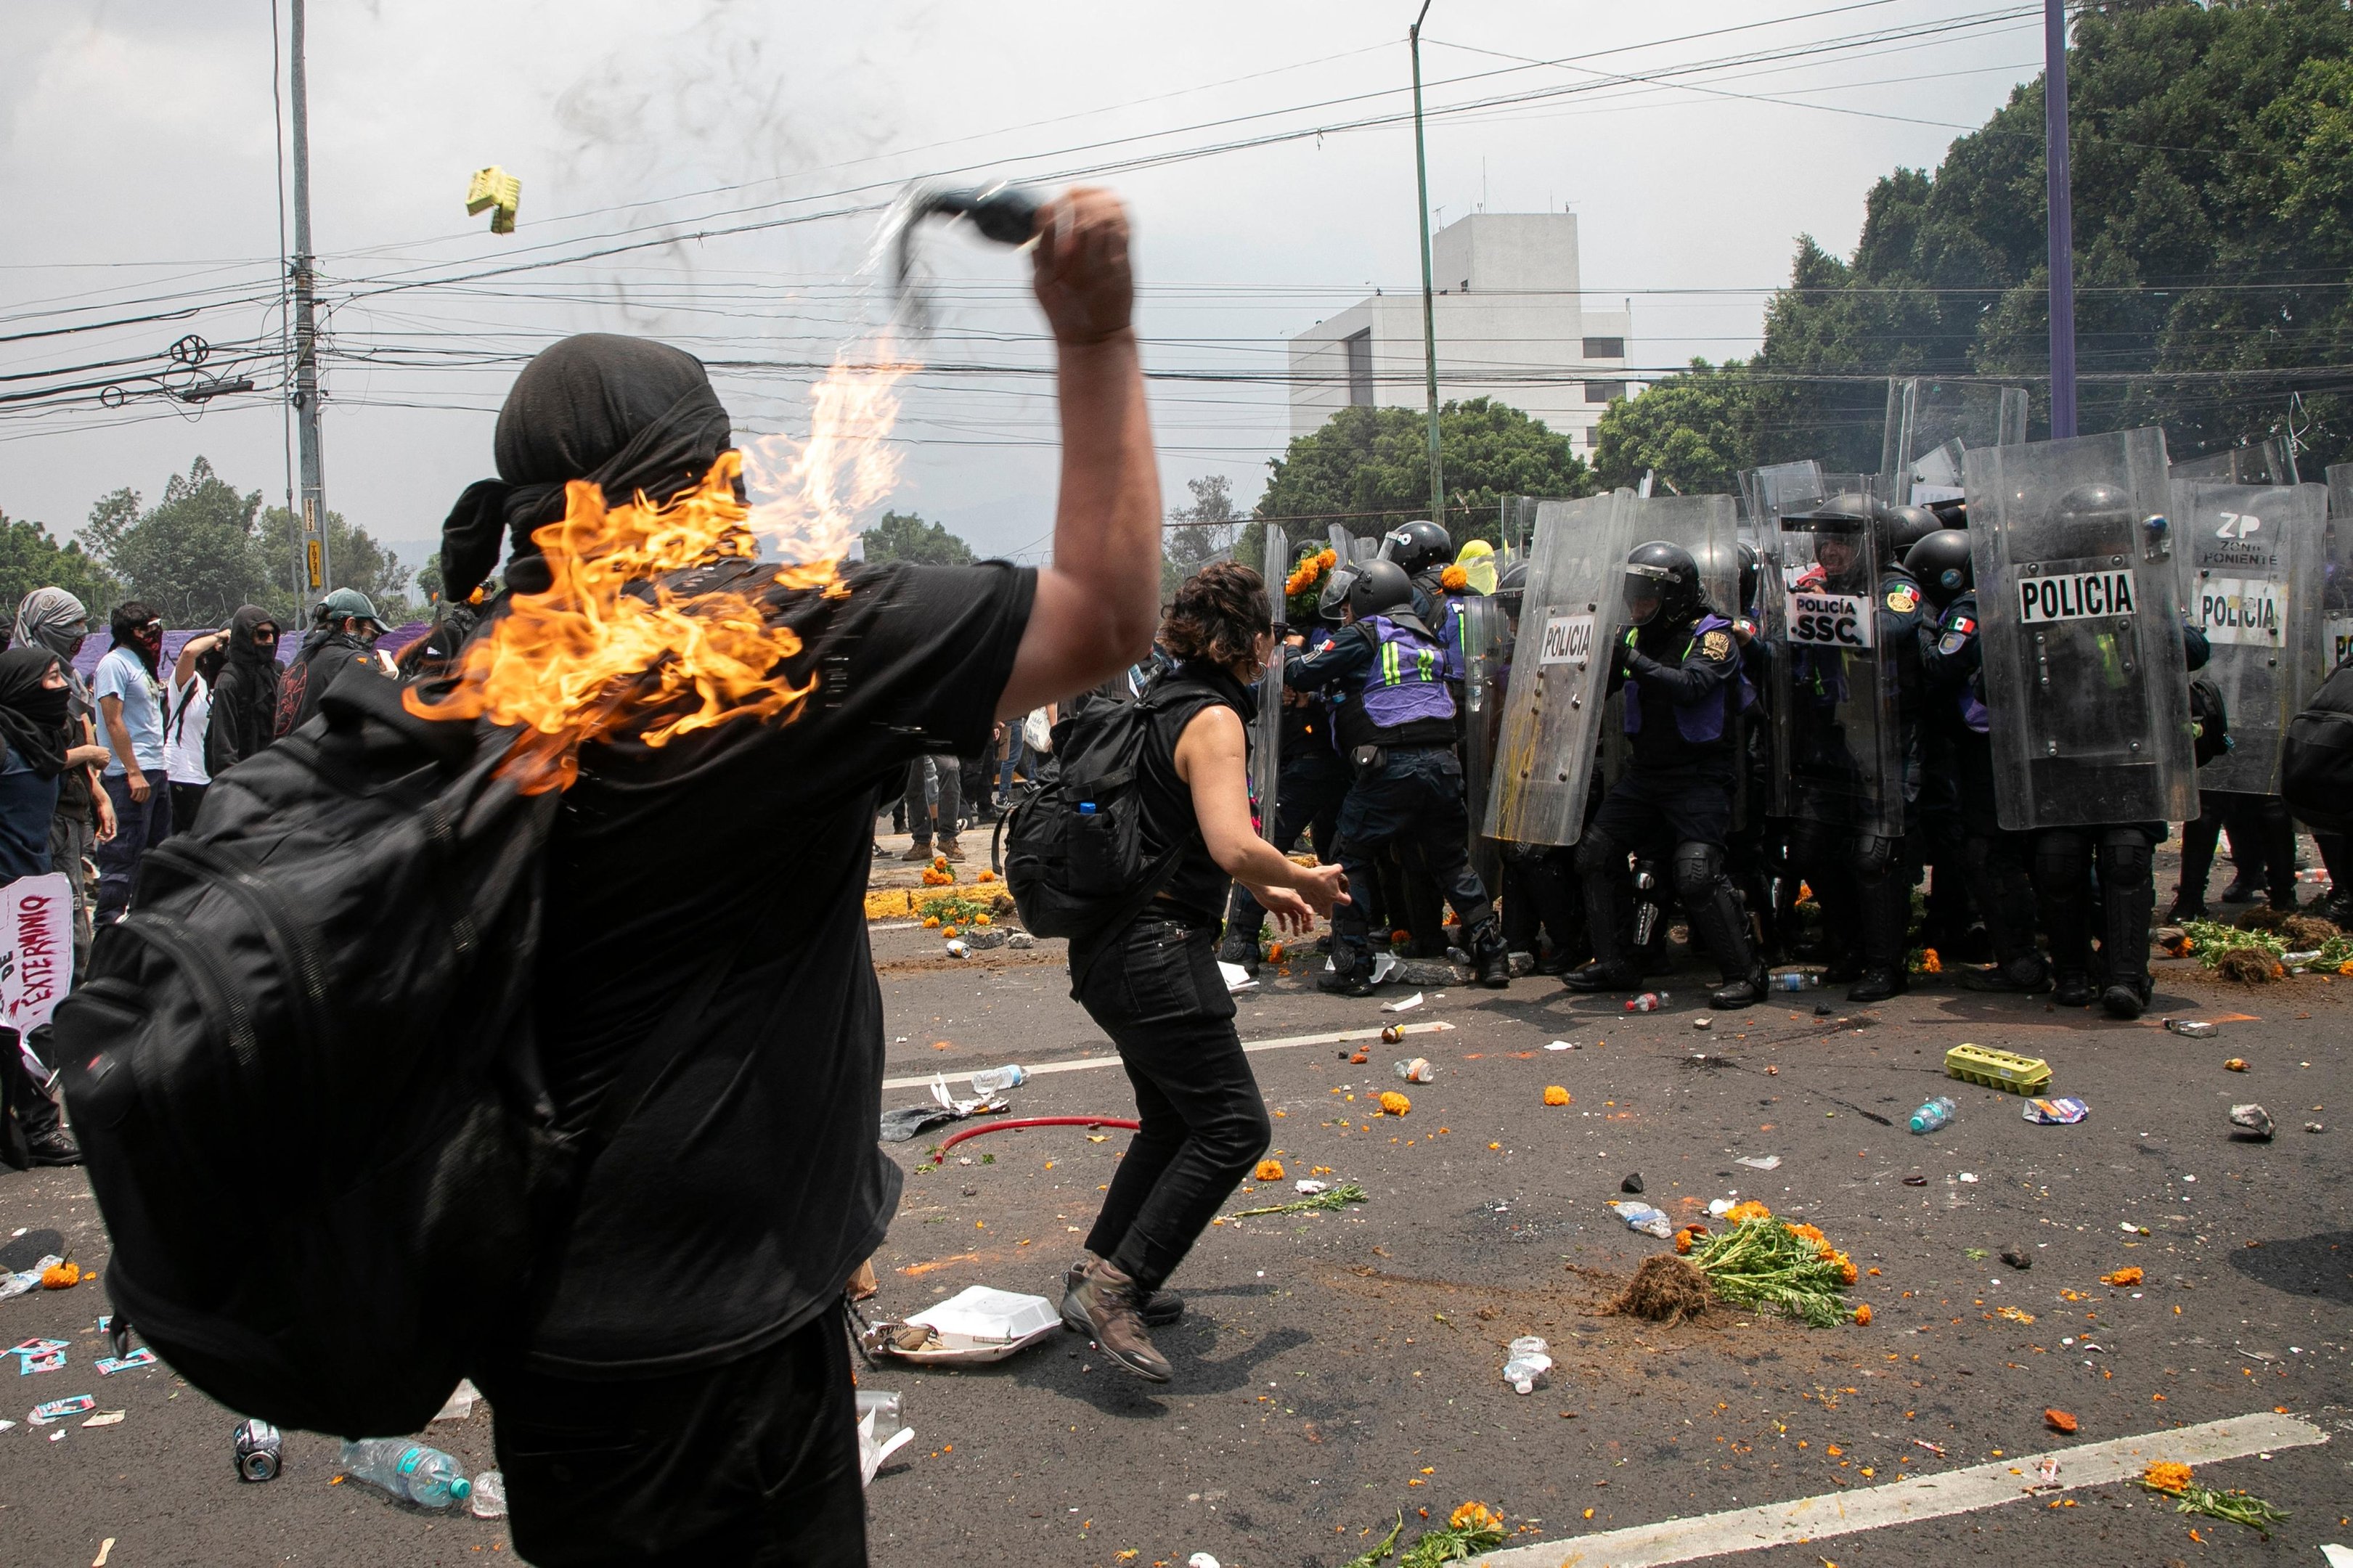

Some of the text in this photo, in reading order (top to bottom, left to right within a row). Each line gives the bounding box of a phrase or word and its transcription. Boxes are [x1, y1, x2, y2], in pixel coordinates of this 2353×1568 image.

[2216, 512, 2260, 539] ZP
[1796, 597, 1856, 615] POLICÍA
[2022, 574, 2133, 619] POLICIA
[2203, 595, 2275, 629] POLICIA
[1543, 624, 1591, 658] POLICIA
[17, 895, 54, 1008] EXTERMINIO
